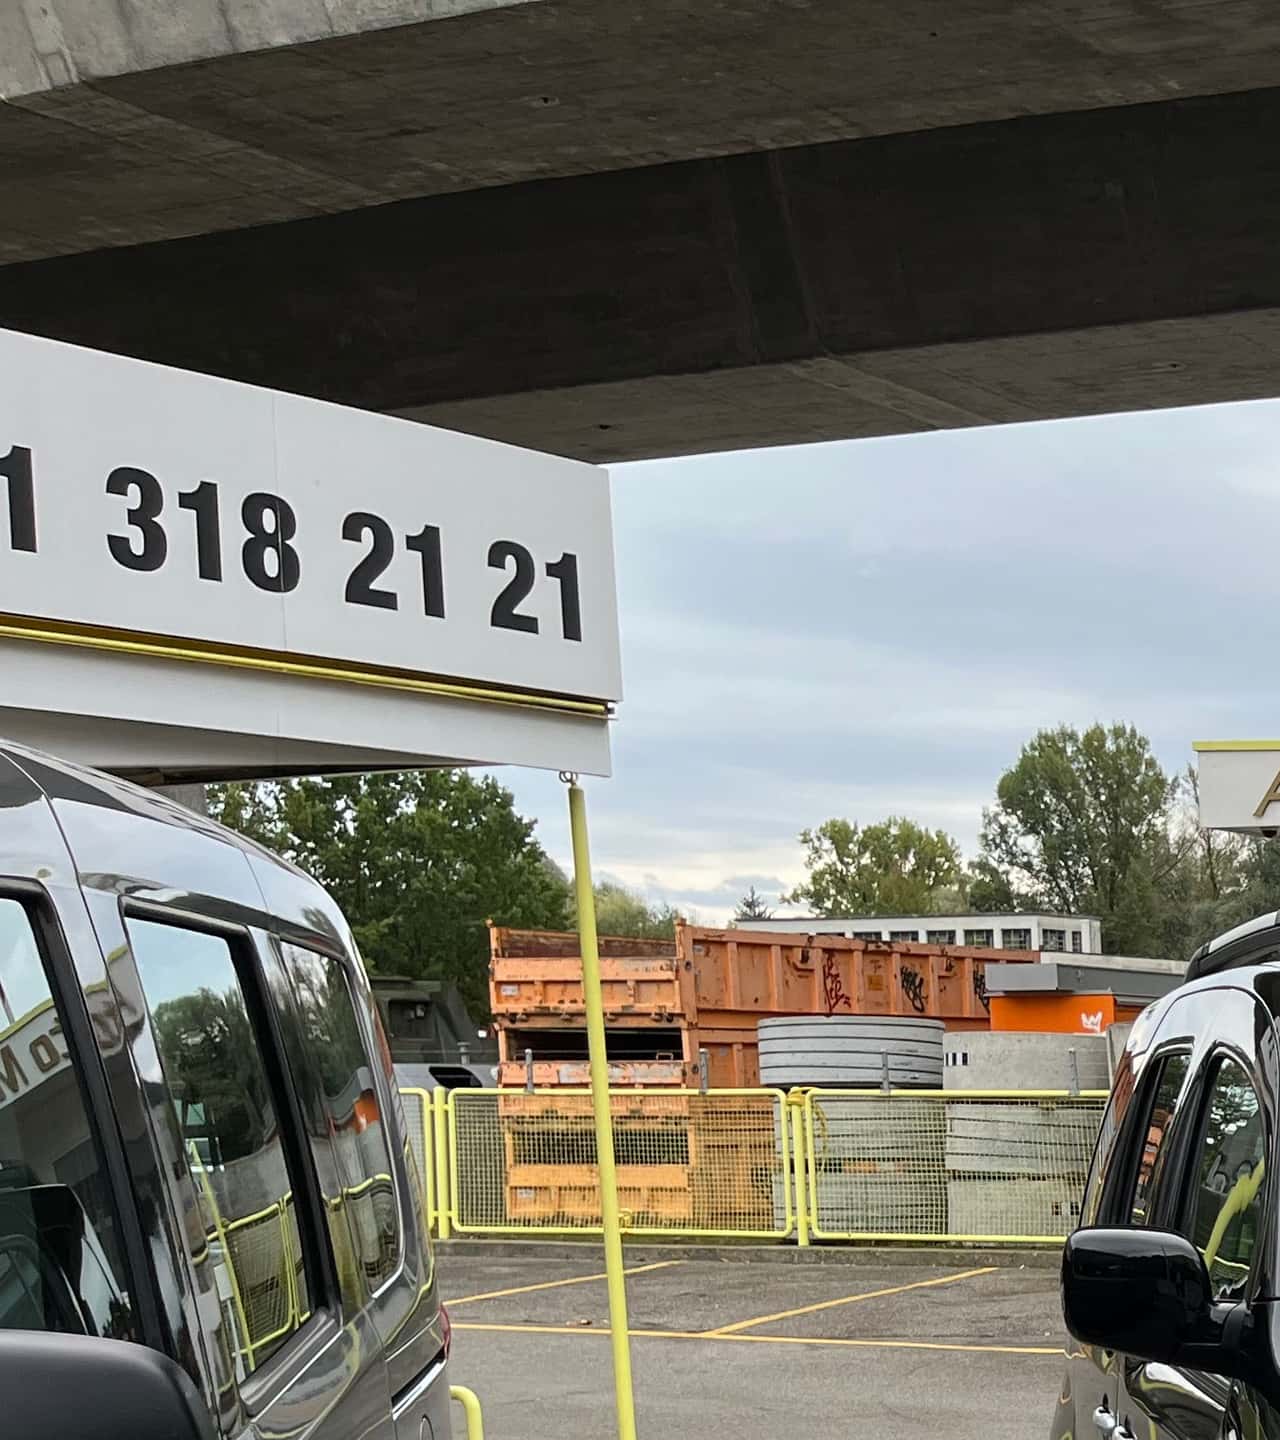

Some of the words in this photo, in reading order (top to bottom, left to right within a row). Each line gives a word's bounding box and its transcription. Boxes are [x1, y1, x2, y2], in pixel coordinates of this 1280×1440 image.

[105, 466, 300, 593] 318
[341, 512, 445, 619] 21
[487, 540, 582, 642] 21
